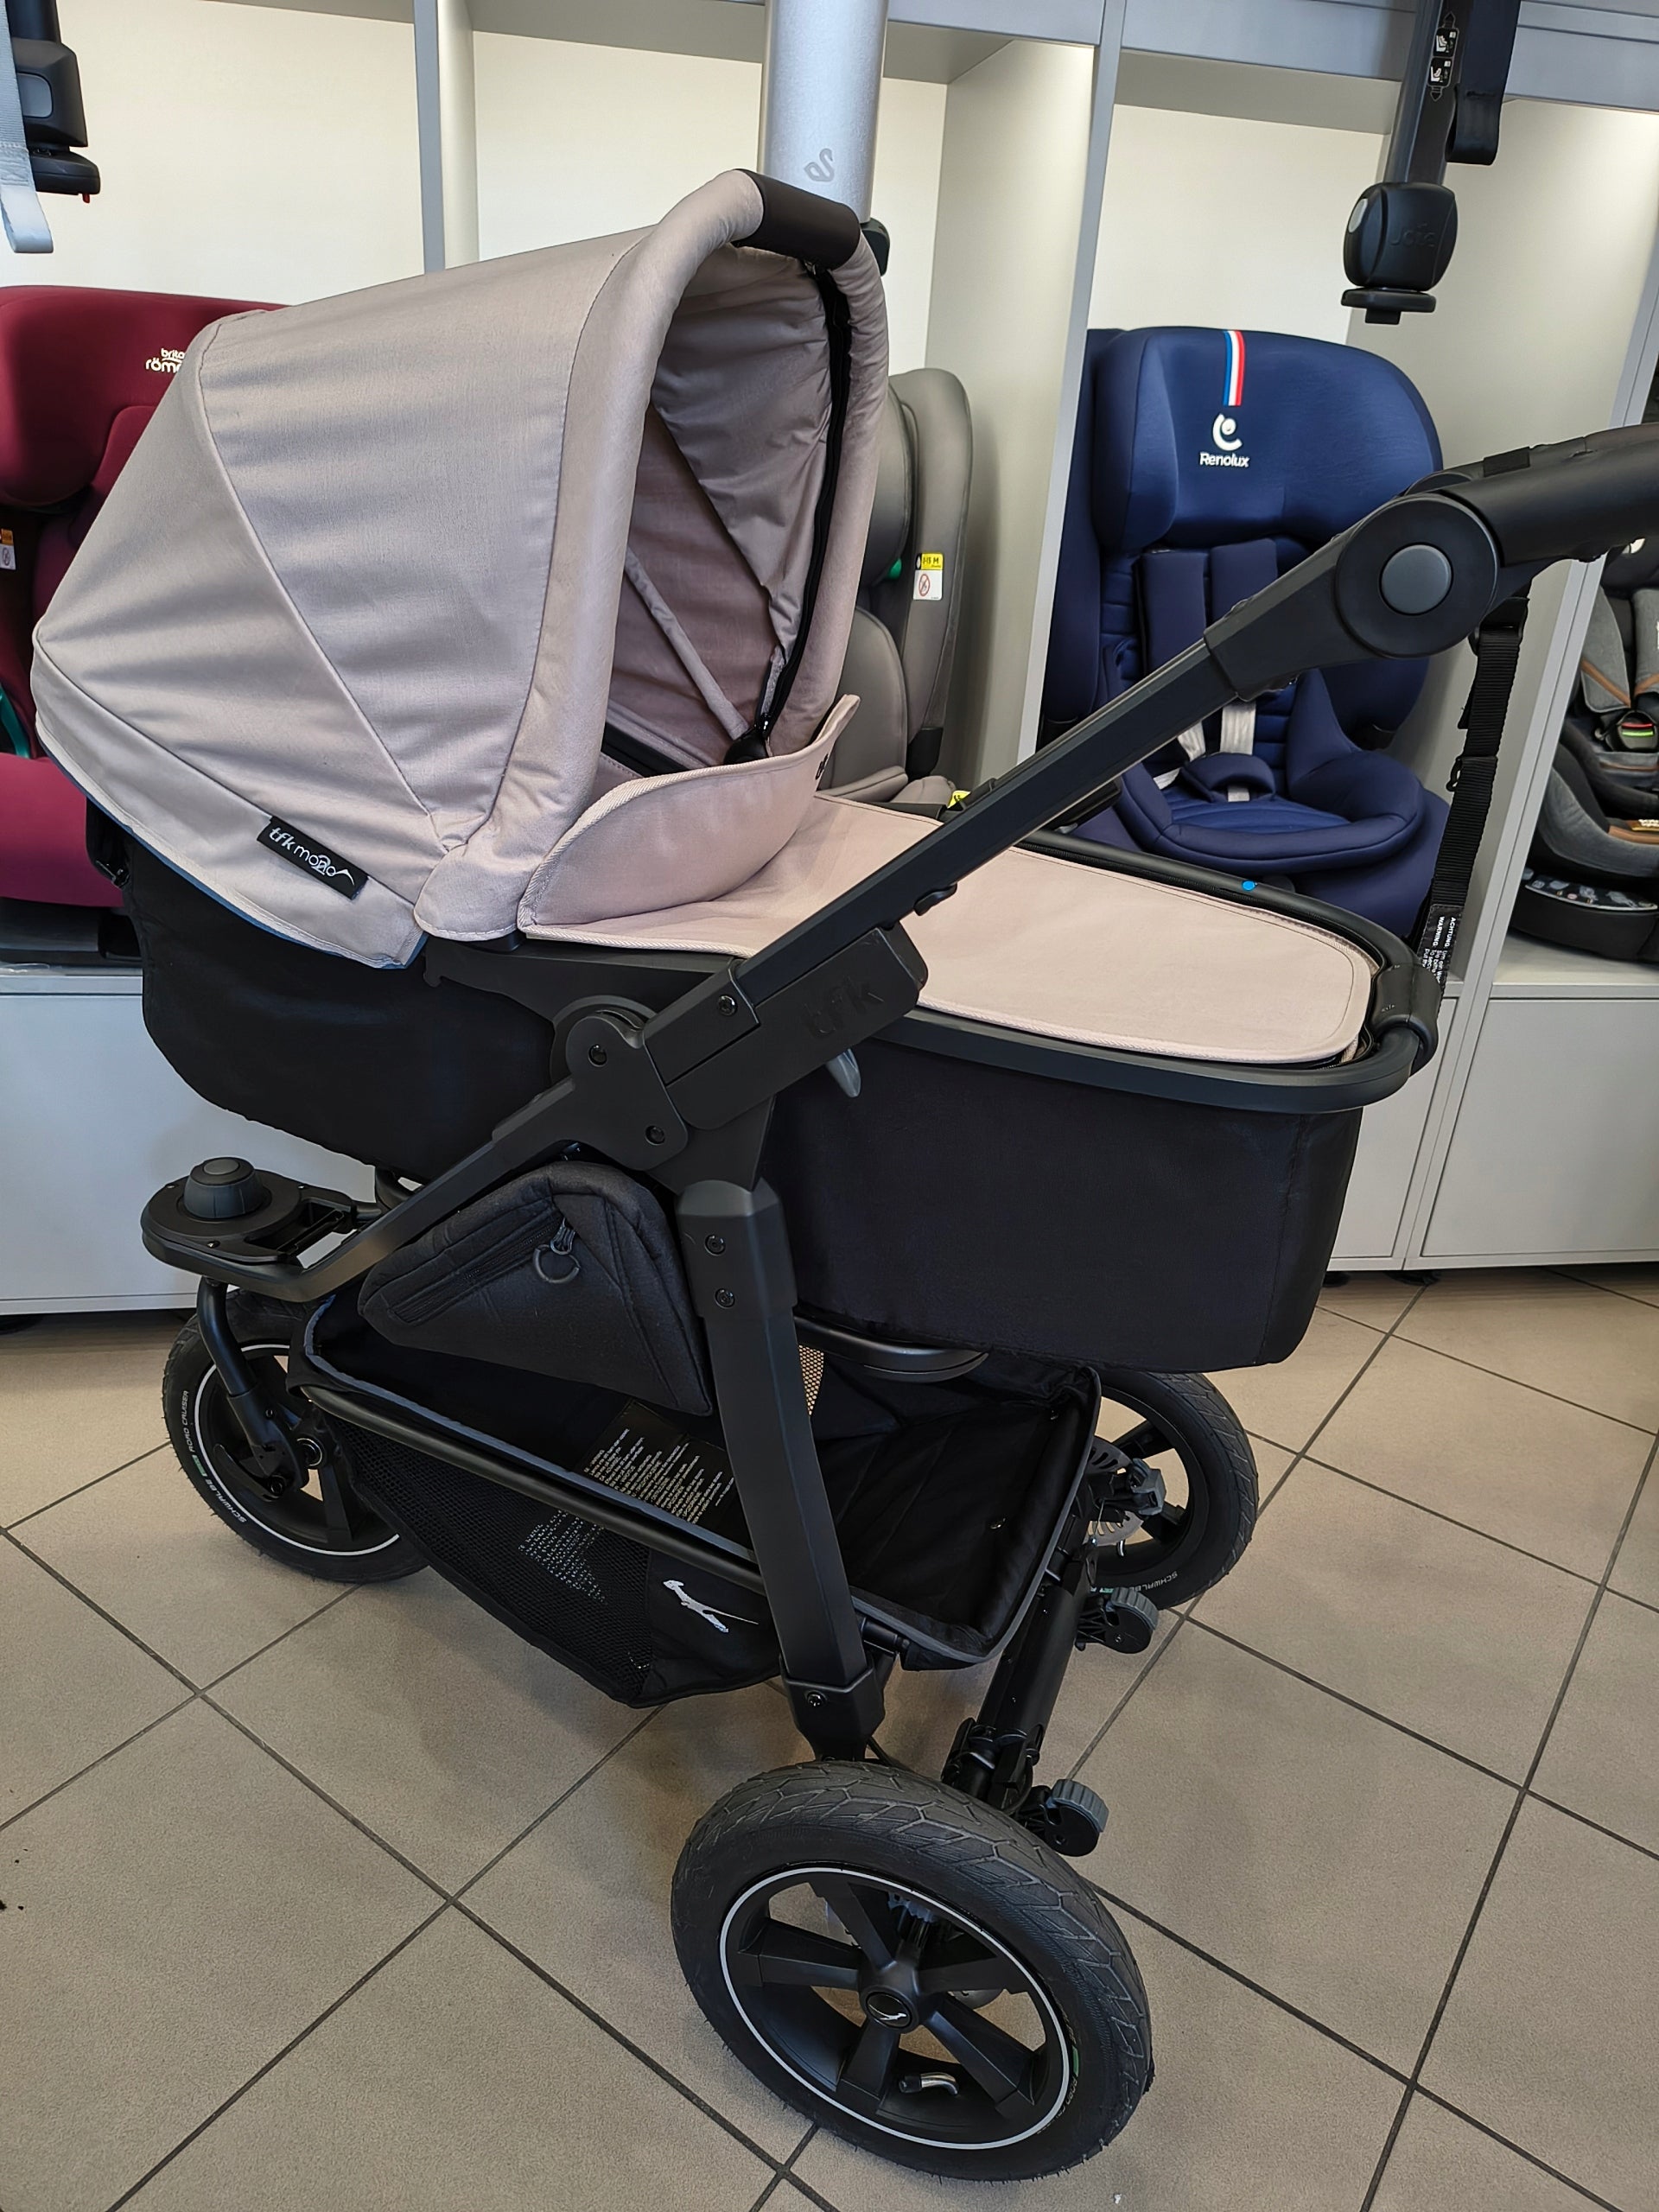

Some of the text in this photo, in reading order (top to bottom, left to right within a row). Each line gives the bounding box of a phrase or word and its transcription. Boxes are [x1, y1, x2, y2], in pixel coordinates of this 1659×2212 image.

[145, 357, 181, 373] röm
[1199, 452, 1250, 467] Renolux
[269, 827, 296, 850] tfk
[183, 1427, 195, 1452] ROAD
[205, 1478, 247, 1523] SCHWALBE
